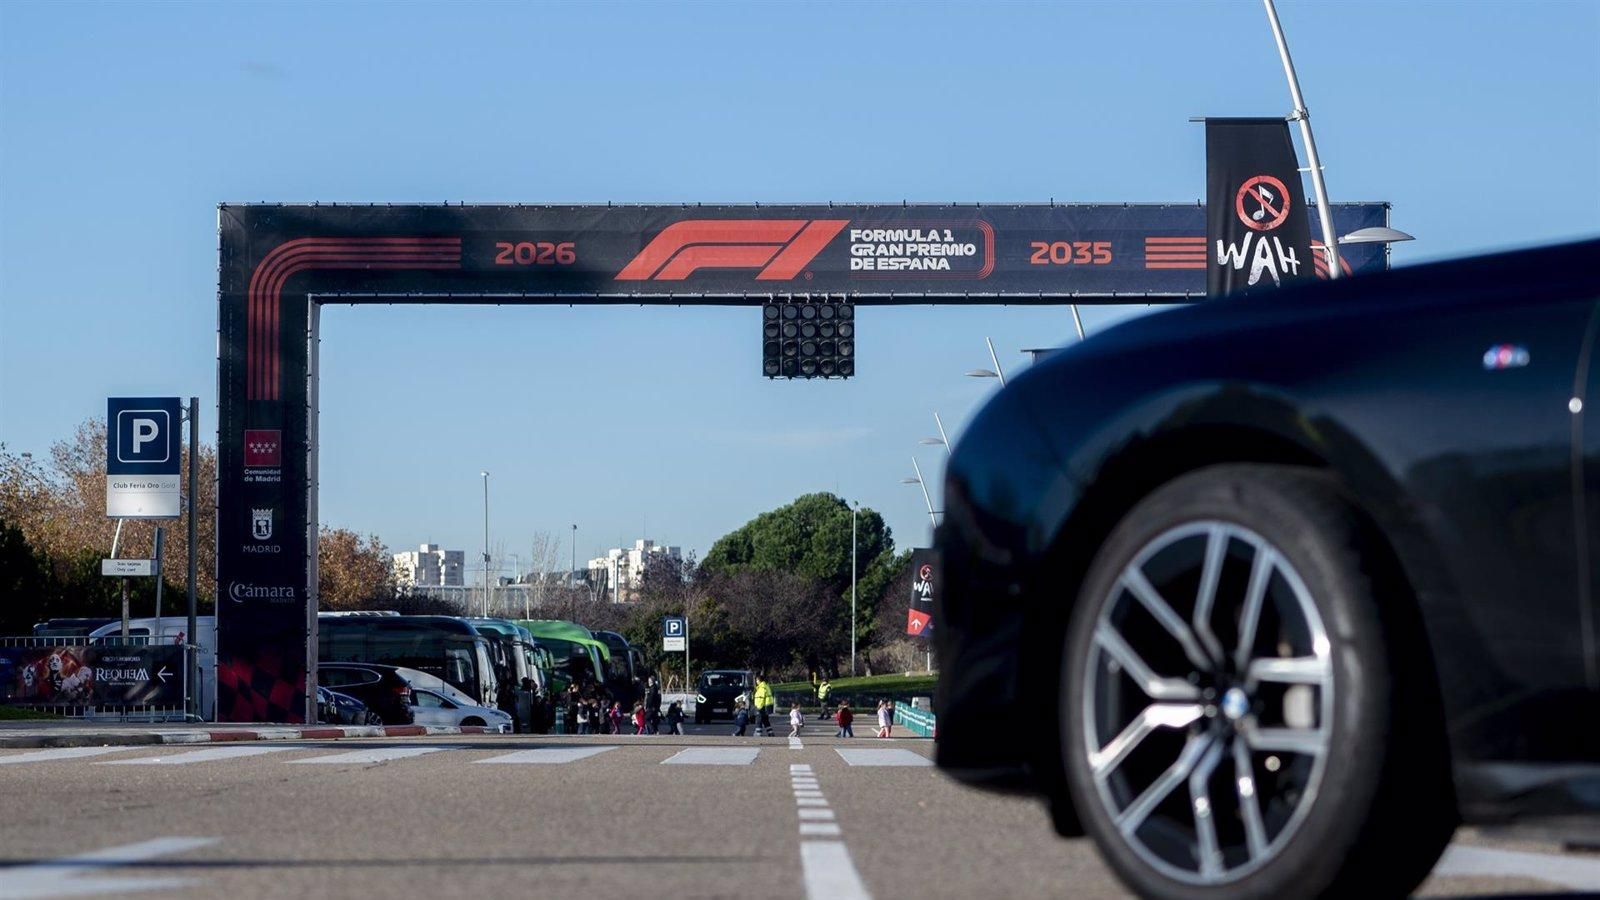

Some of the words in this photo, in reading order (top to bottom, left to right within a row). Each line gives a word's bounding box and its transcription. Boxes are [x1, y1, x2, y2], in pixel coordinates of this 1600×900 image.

[850, 229, 941, 242] FORMULA
[944, 229, 954, 242] 1
[495, 242, 576, 265] 2026
[850, 243, 903, 256] GRAN
[906, 243, 977, 256] PREMIO
[1030, 241, 1112, 265] 2035
[850, 257, 875, 270] DE
[877, 256, 951, 270] ESPAÑA
[1216, 231, 1301, 288] WAH
[132, 418, 159, 454] P
[242, 545, 281, 553] MADRID
[234, 583, 295, 598] Cámara
[670, 623, 679, 633] P
